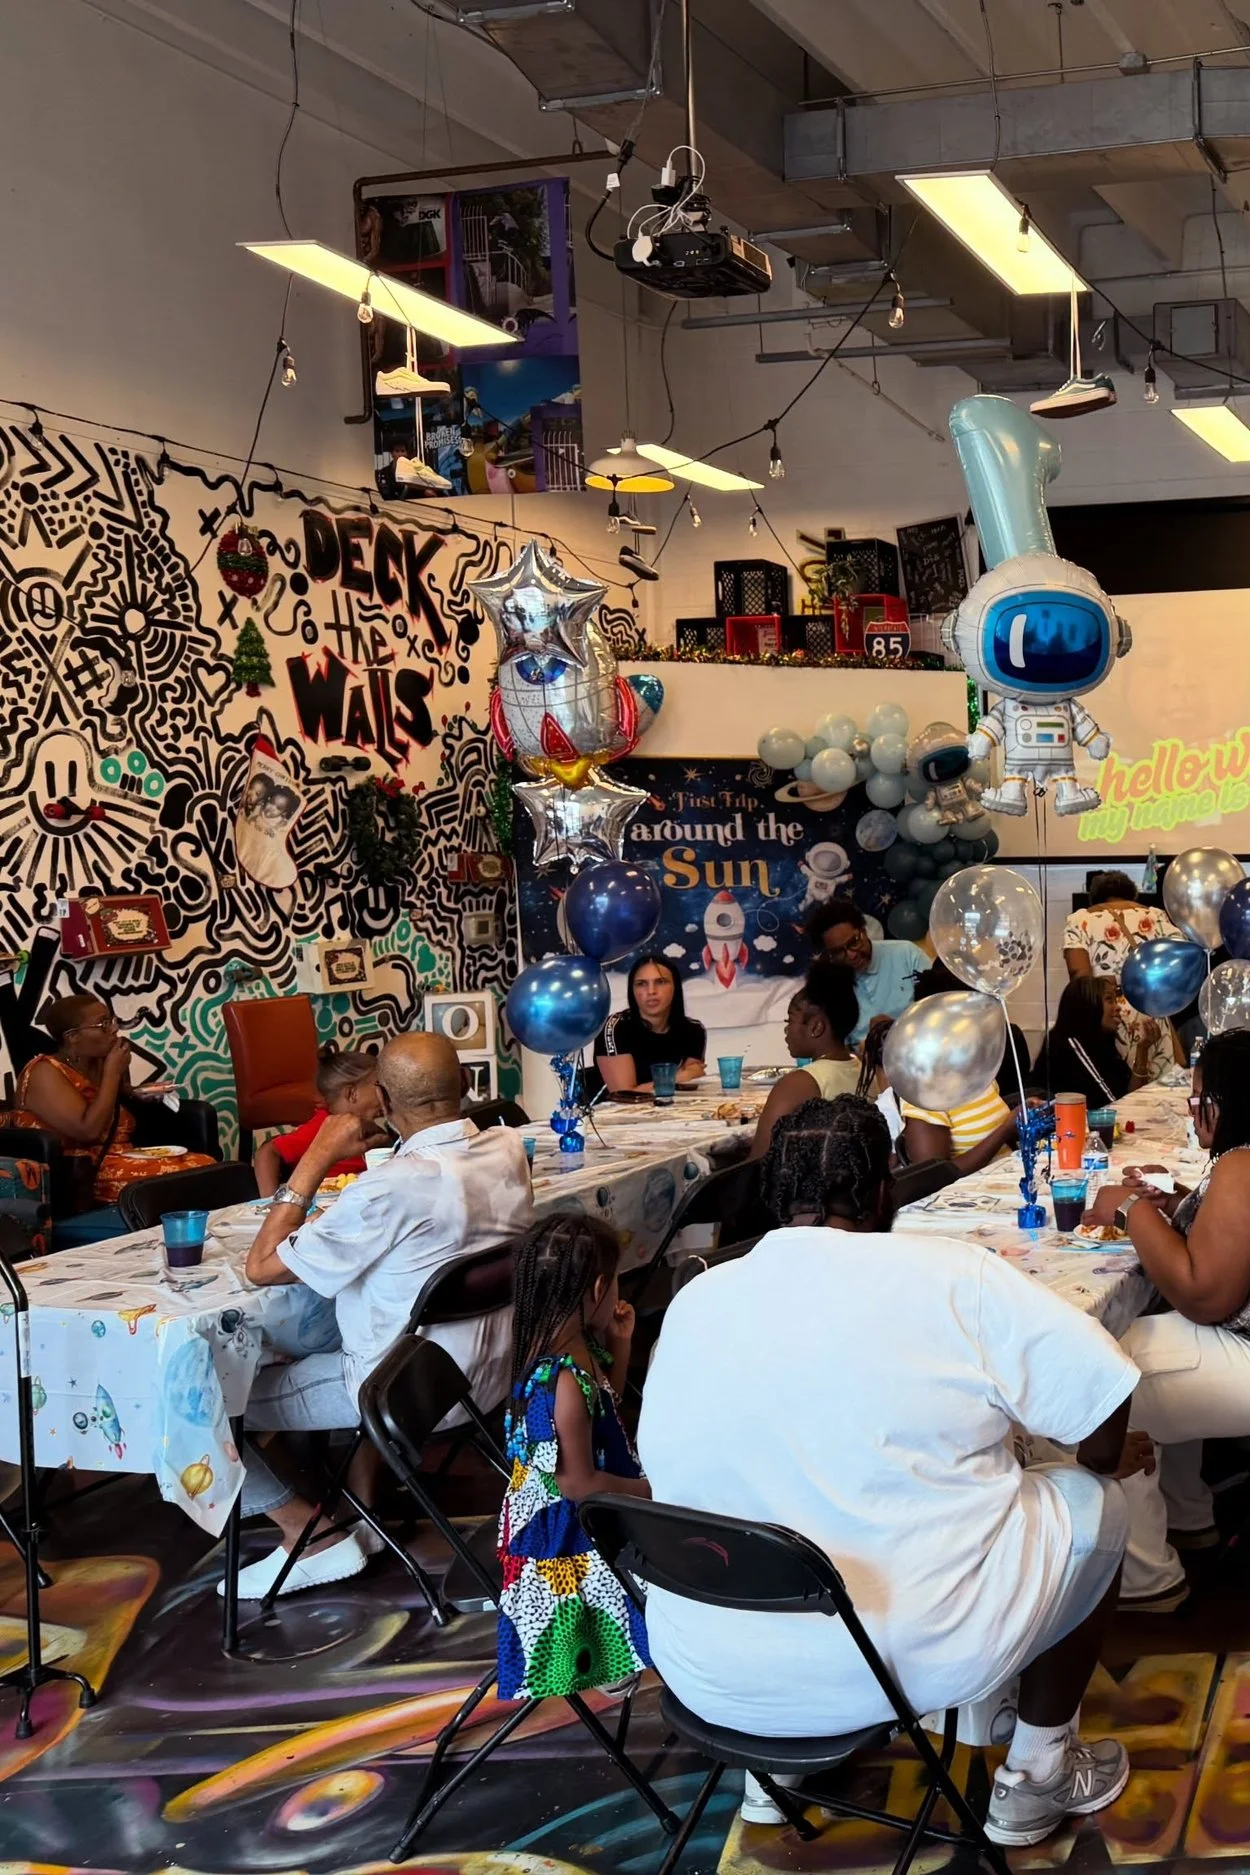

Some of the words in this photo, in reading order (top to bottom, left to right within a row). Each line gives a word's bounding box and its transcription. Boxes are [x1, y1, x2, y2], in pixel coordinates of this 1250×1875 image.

[418, 208, 441, 220] DGK
[299, 509, 452, 655] DECK
[324, 589, 397, 667] the
[872, 637, 903, 659] 85
[1099, 742, 1208, 805] hello
[630, 813, 745, 847] around
[756, 812, 805, 846] the
[1079, 806, 1129, 842] my
[1131, 789, 1216, 831] name
[662, 846, 780, 898] Sun
[442, 1004, 479, 1041] O
[1071, 1769, 1092, 1799] N
